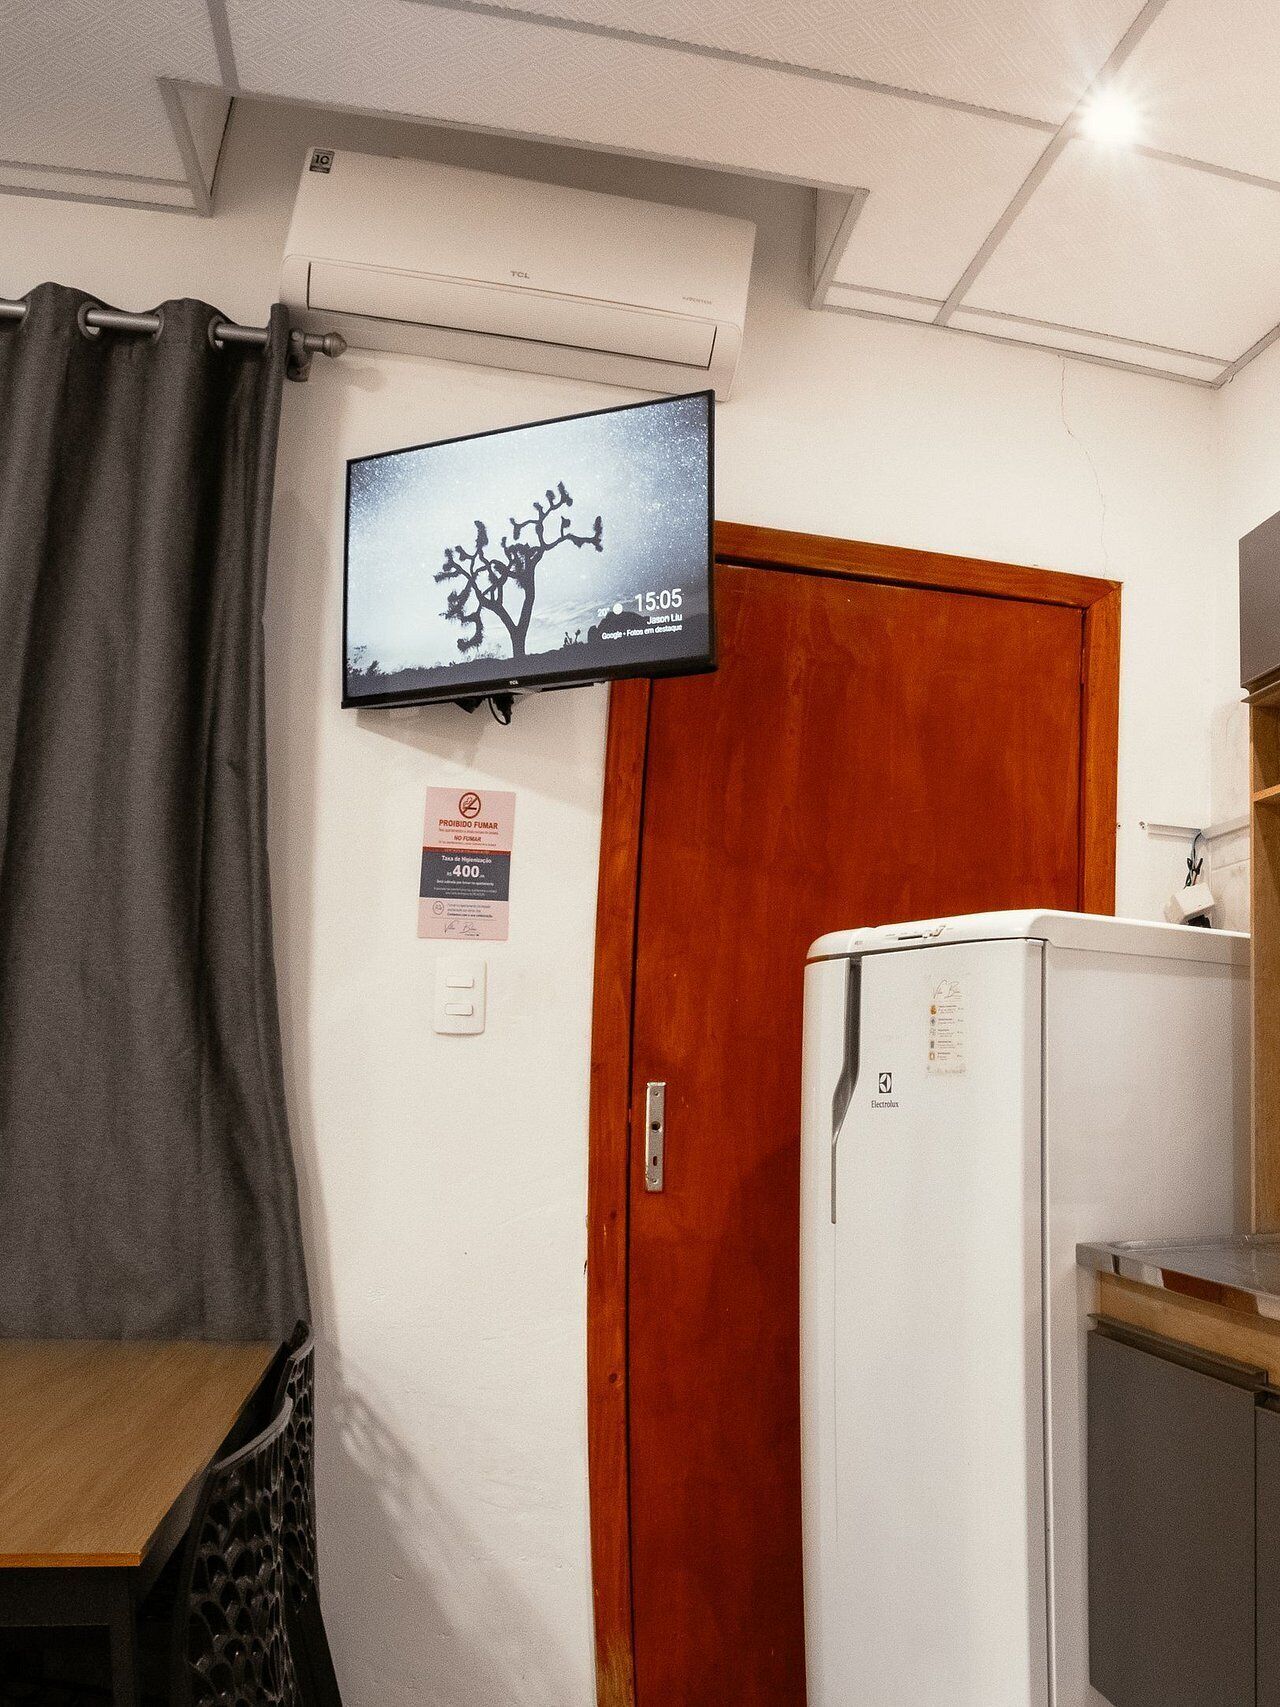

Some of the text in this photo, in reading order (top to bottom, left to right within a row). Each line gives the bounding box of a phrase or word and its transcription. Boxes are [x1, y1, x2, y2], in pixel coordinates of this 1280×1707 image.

[315, 154, 330, 165] 10
[510, 270, 530, 279] TCL
[634, 588, 683, 612] 15:05
[646, 613, 683, 625] Jason Liu
[601, 624, 683, 640] Google Fotos em destaque
[438, 819, 498, 830] PROIBIDO FUMAR
[870, 1100, 899, 1109] Electrolux
